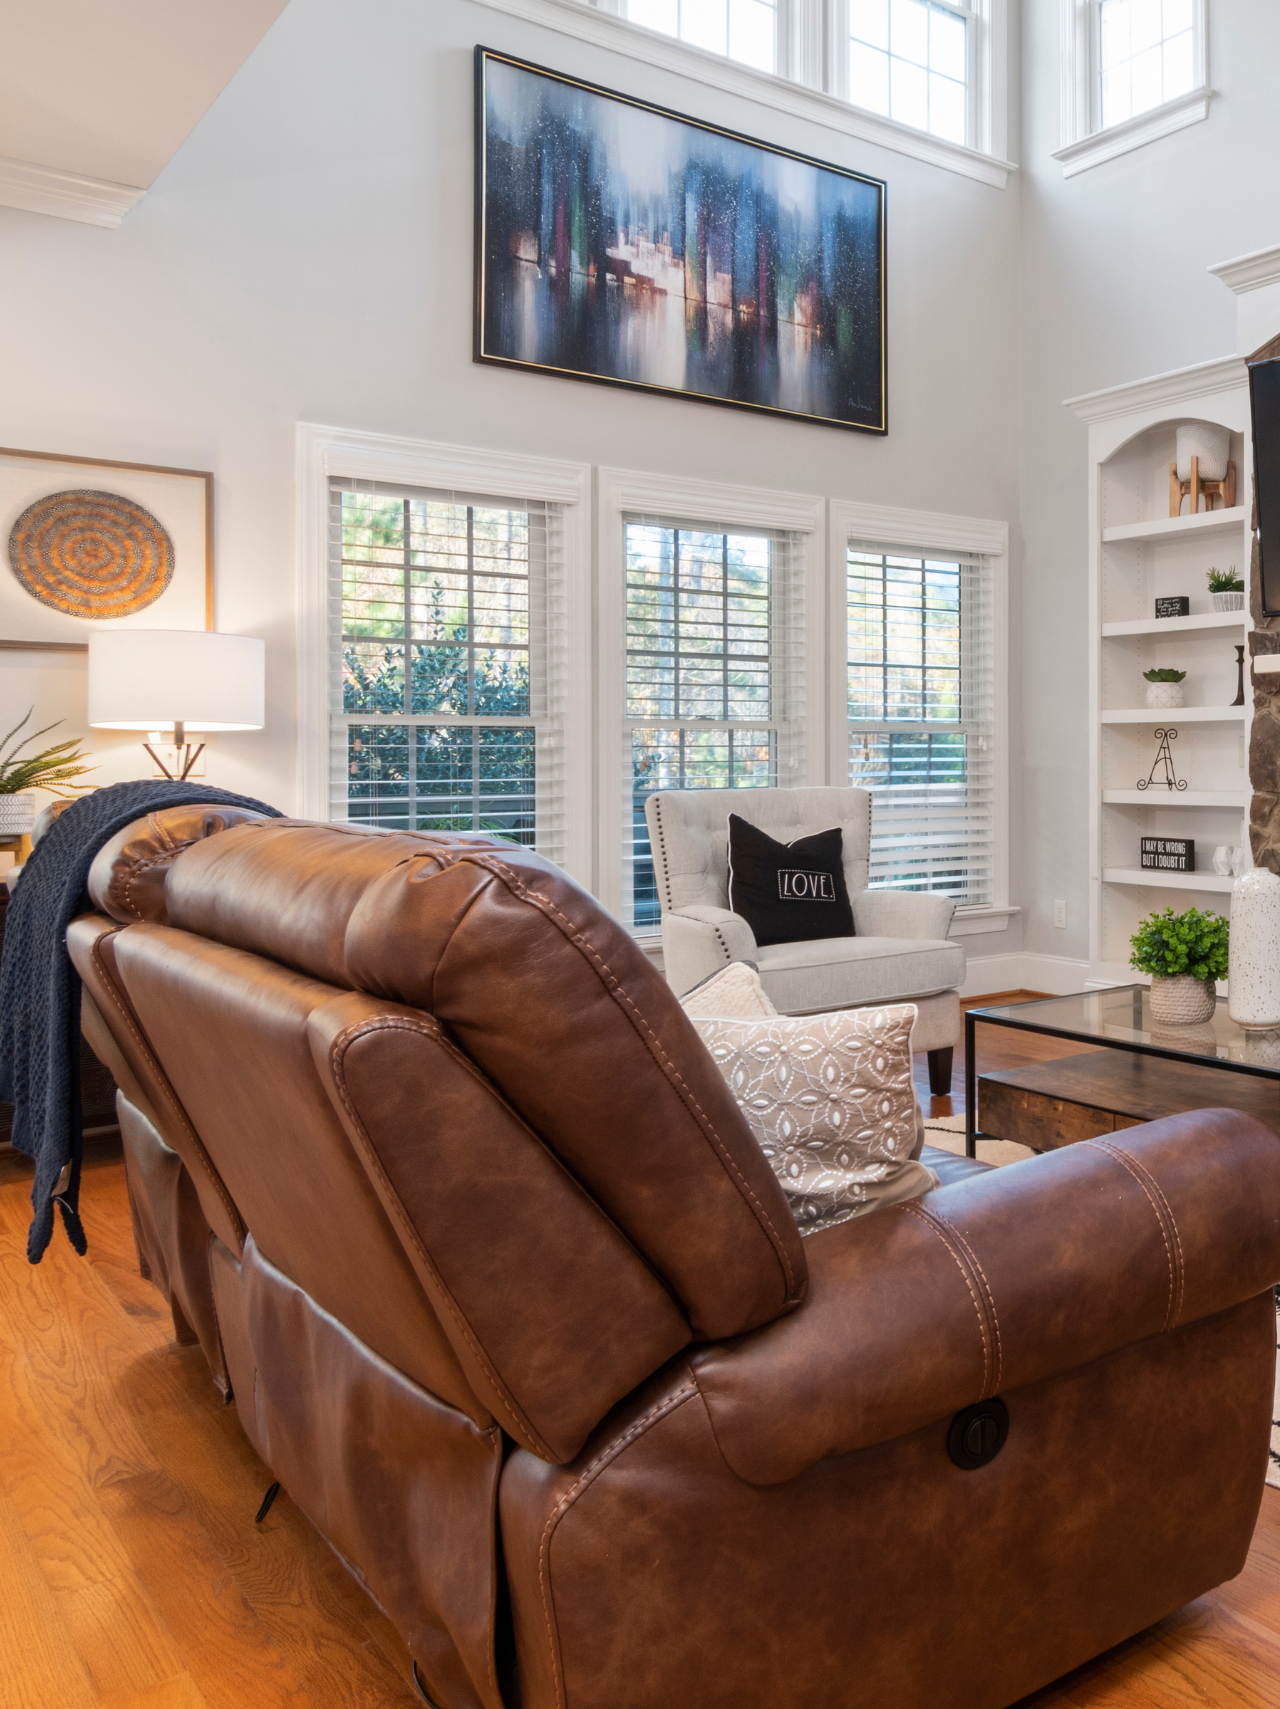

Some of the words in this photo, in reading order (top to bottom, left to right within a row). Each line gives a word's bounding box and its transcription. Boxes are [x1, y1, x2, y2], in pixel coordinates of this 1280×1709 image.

[1142, 840, 1145, 850] I
[1146, 840, 1157, 852] MAY
[1158, 841, 1164, 852] BE
[1165, 842, 1186, 854] WRONG
[1143, 853, 1154, 866] BUT
[1155, 855, 1158, 866] I
[1159, 855, 1178, 868] DOUBT
[1180, 857, 1186, 869] IT
